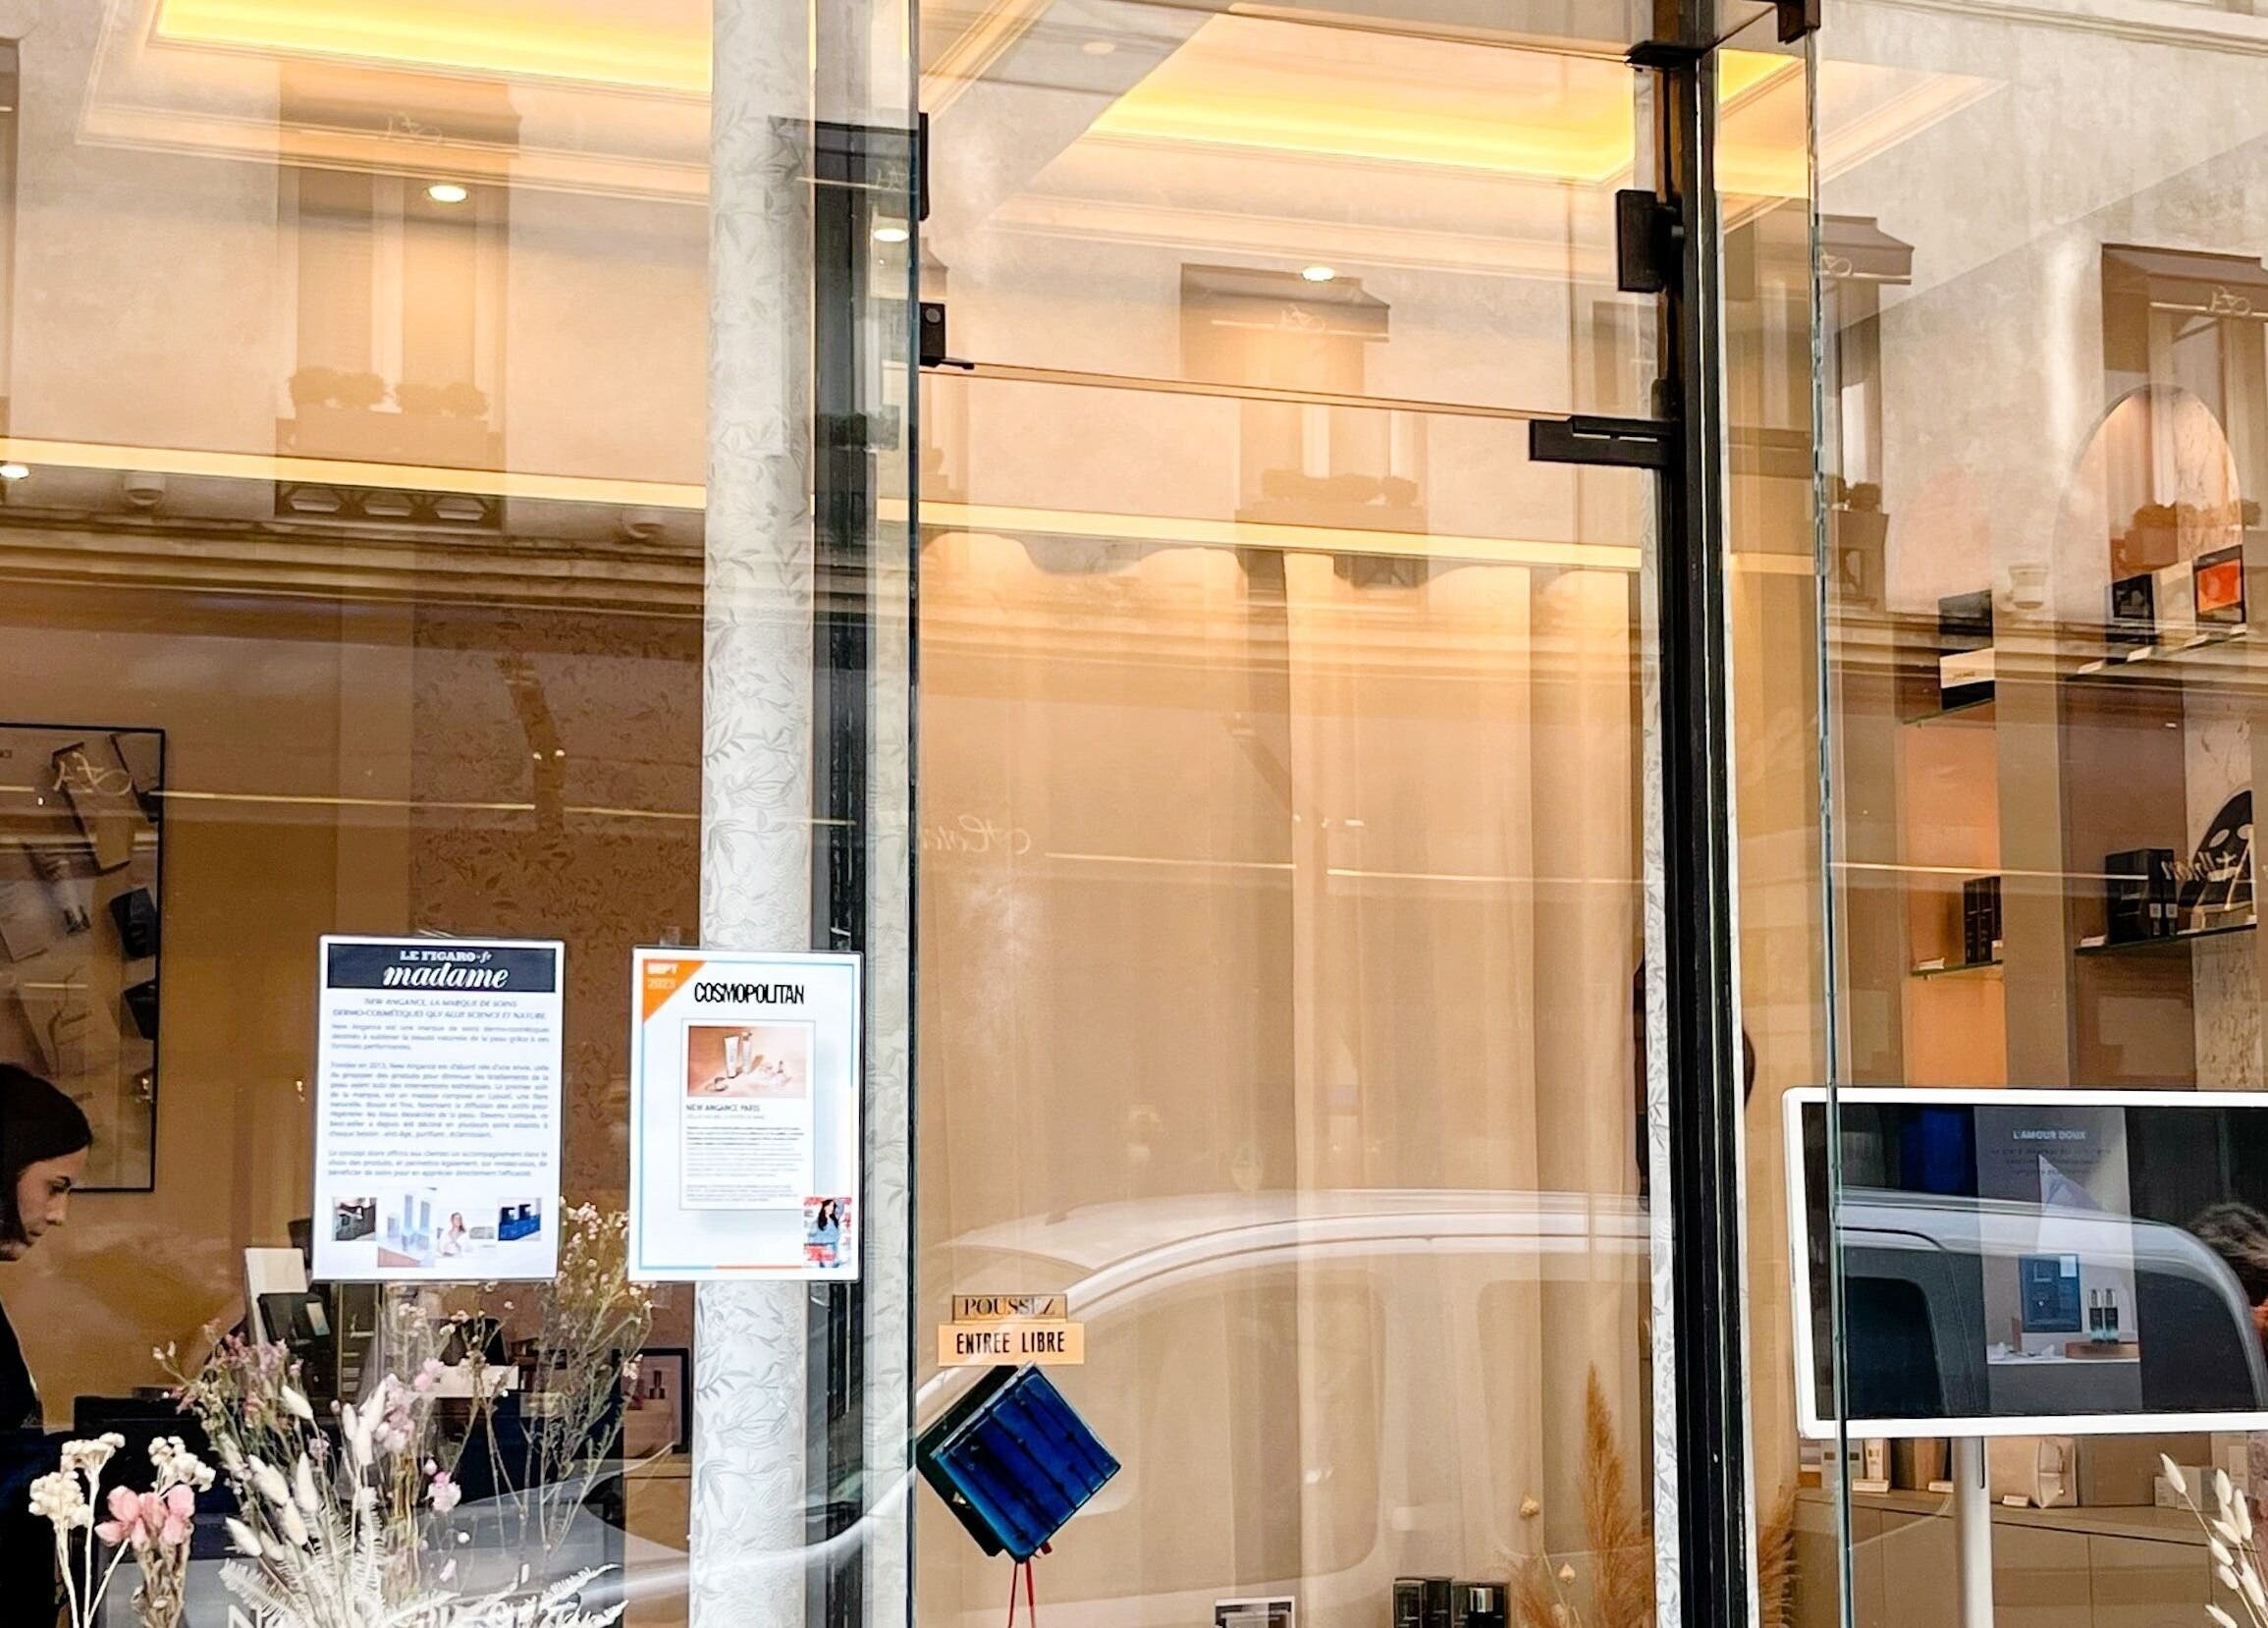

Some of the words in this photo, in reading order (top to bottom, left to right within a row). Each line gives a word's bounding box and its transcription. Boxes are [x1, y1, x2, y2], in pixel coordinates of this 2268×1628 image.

[400, 950, 419, 961] LE
[382, 962, 510, 989] madame
[694, 982, 805, 1004] COSMOPOLITAN
[956, 1331, 1011, 1355] ENTREE
[1021, 1330, 1065, 1353] LIBRE
